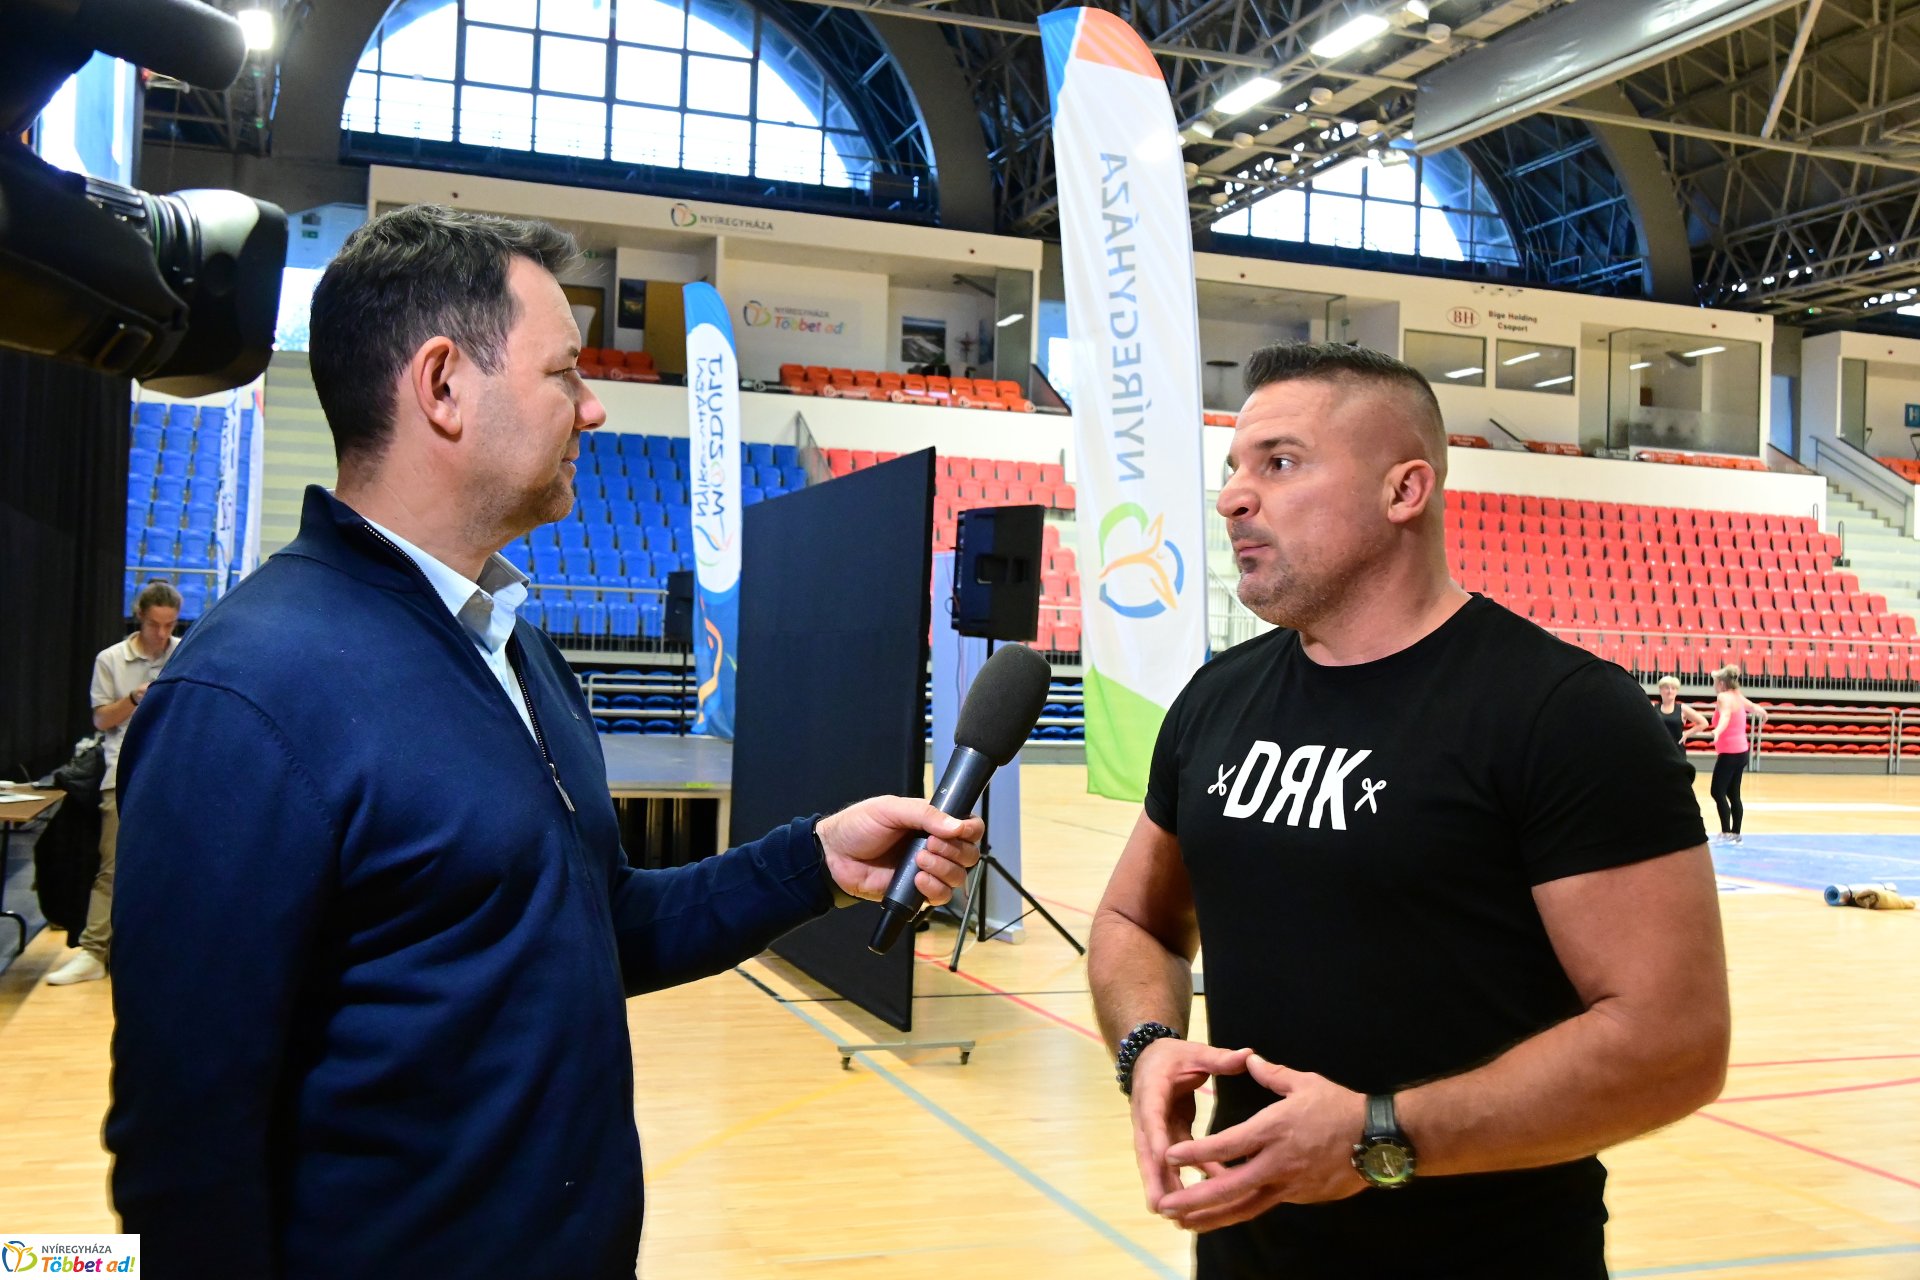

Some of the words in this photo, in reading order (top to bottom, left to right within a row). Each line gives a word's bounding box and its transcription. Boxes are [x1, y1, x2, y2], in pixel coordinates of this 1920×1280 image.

[700, 214, 774, 231] NYÍREGYHÁZA
[1453, 310, 1475, 325] BH
[1508, 312, 1537, 323] Holding
[1497, 322, 1528, 332] Csoport
